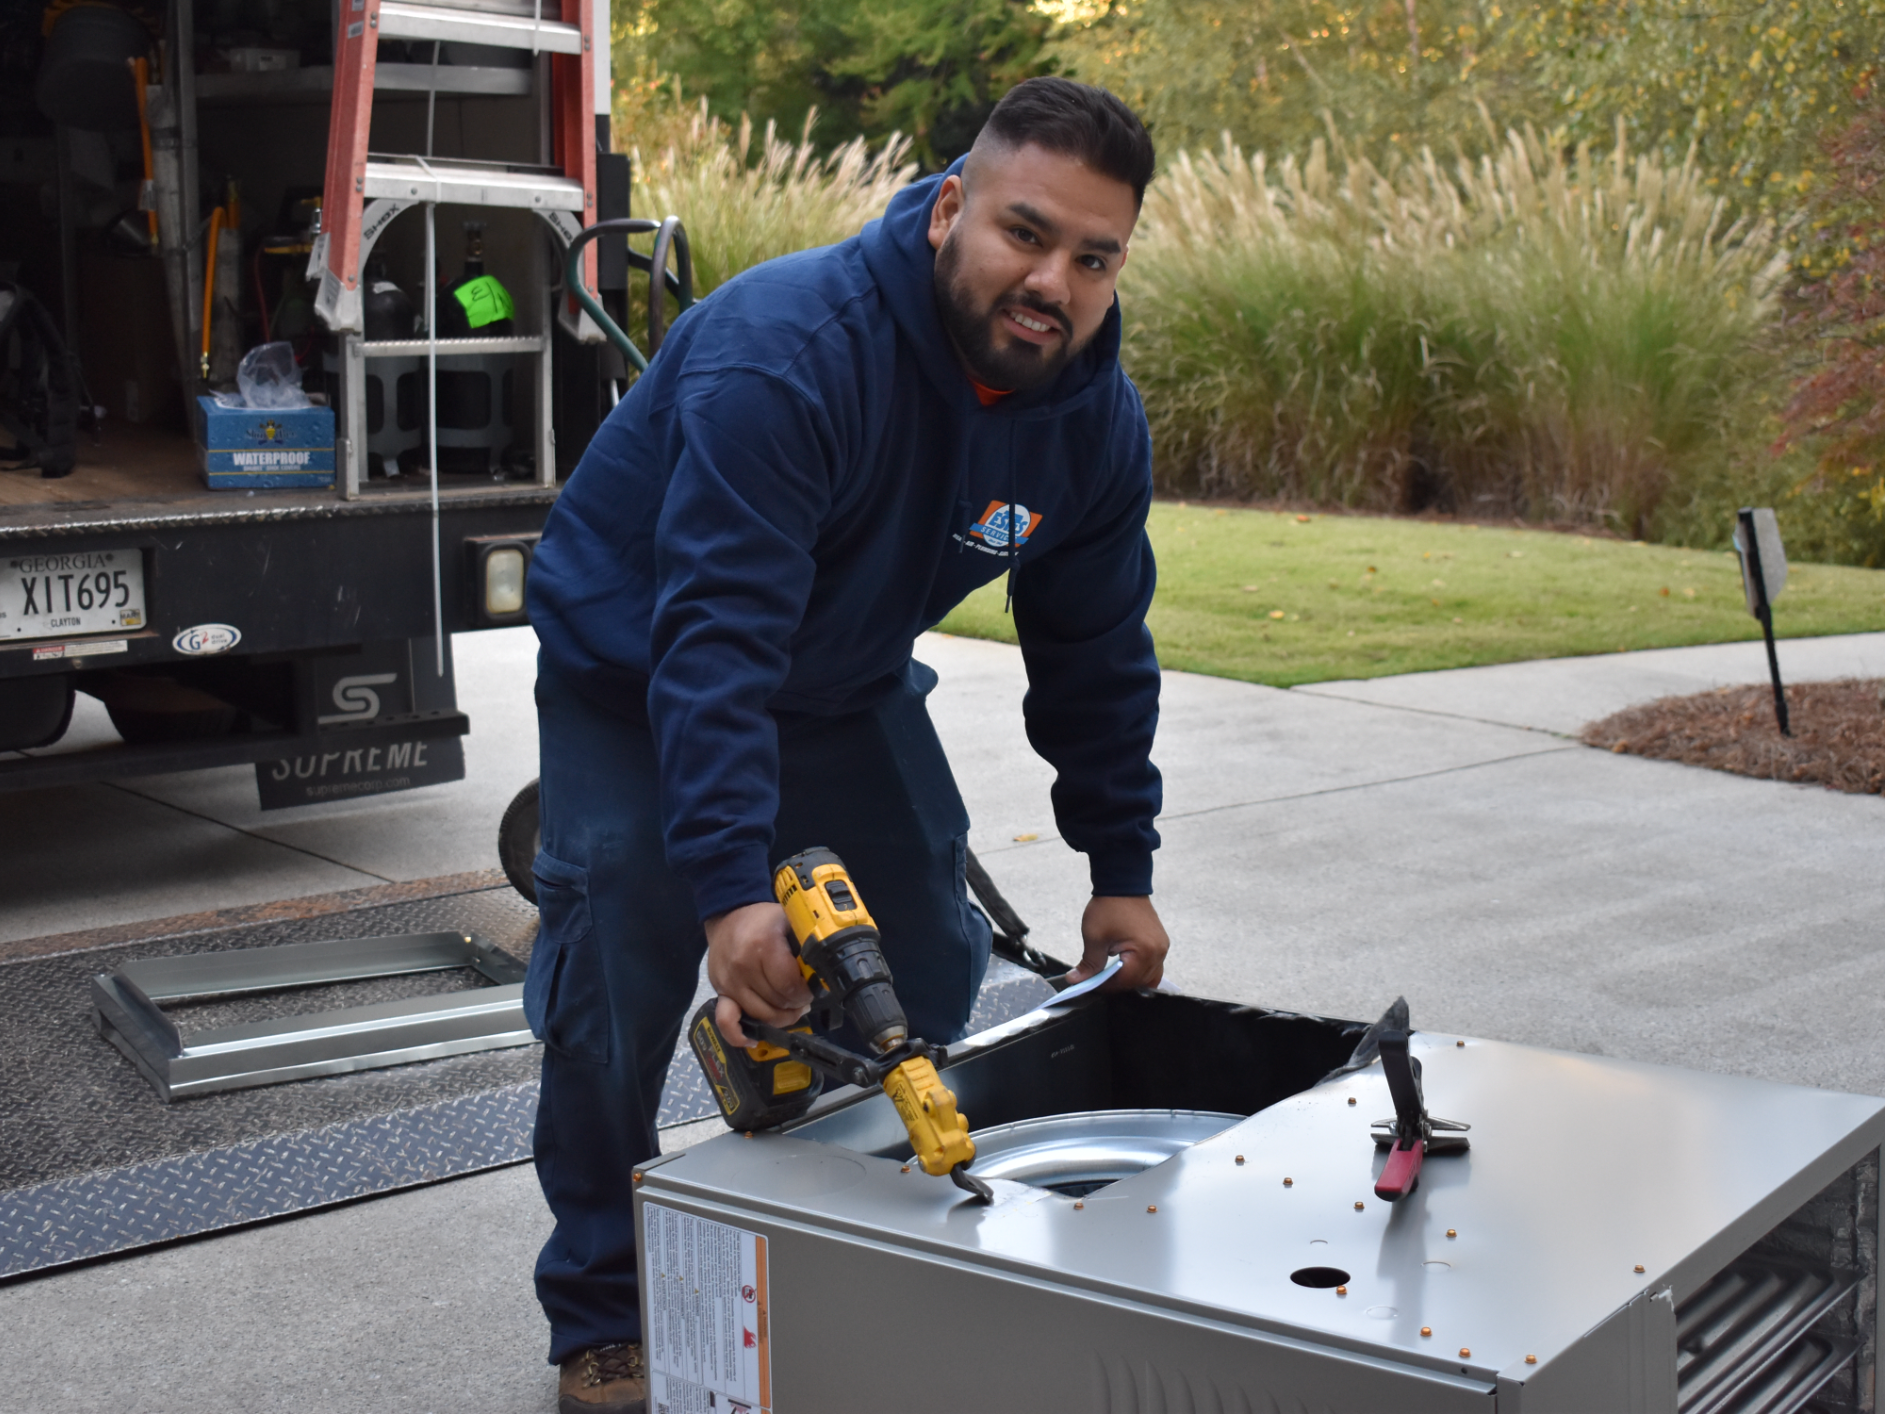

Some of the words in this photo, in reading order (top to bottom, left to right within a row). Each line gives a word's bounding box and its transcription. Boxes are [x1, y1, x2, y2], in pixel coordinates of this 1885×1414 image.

[363, 203, 400, 240] SHOX
[548, 211, 574, 242] SHO
[233, 451, 310, 466] WATERPROOF
[980, 526, 1018, 543] SERVIC
[20, 554, 106, 573] GEORGIA
[21, 570, 130, 616] XIT695
[50, 617, 81, 628] CLAYTON
[305, 776, 411, 797] supremecorp.com
